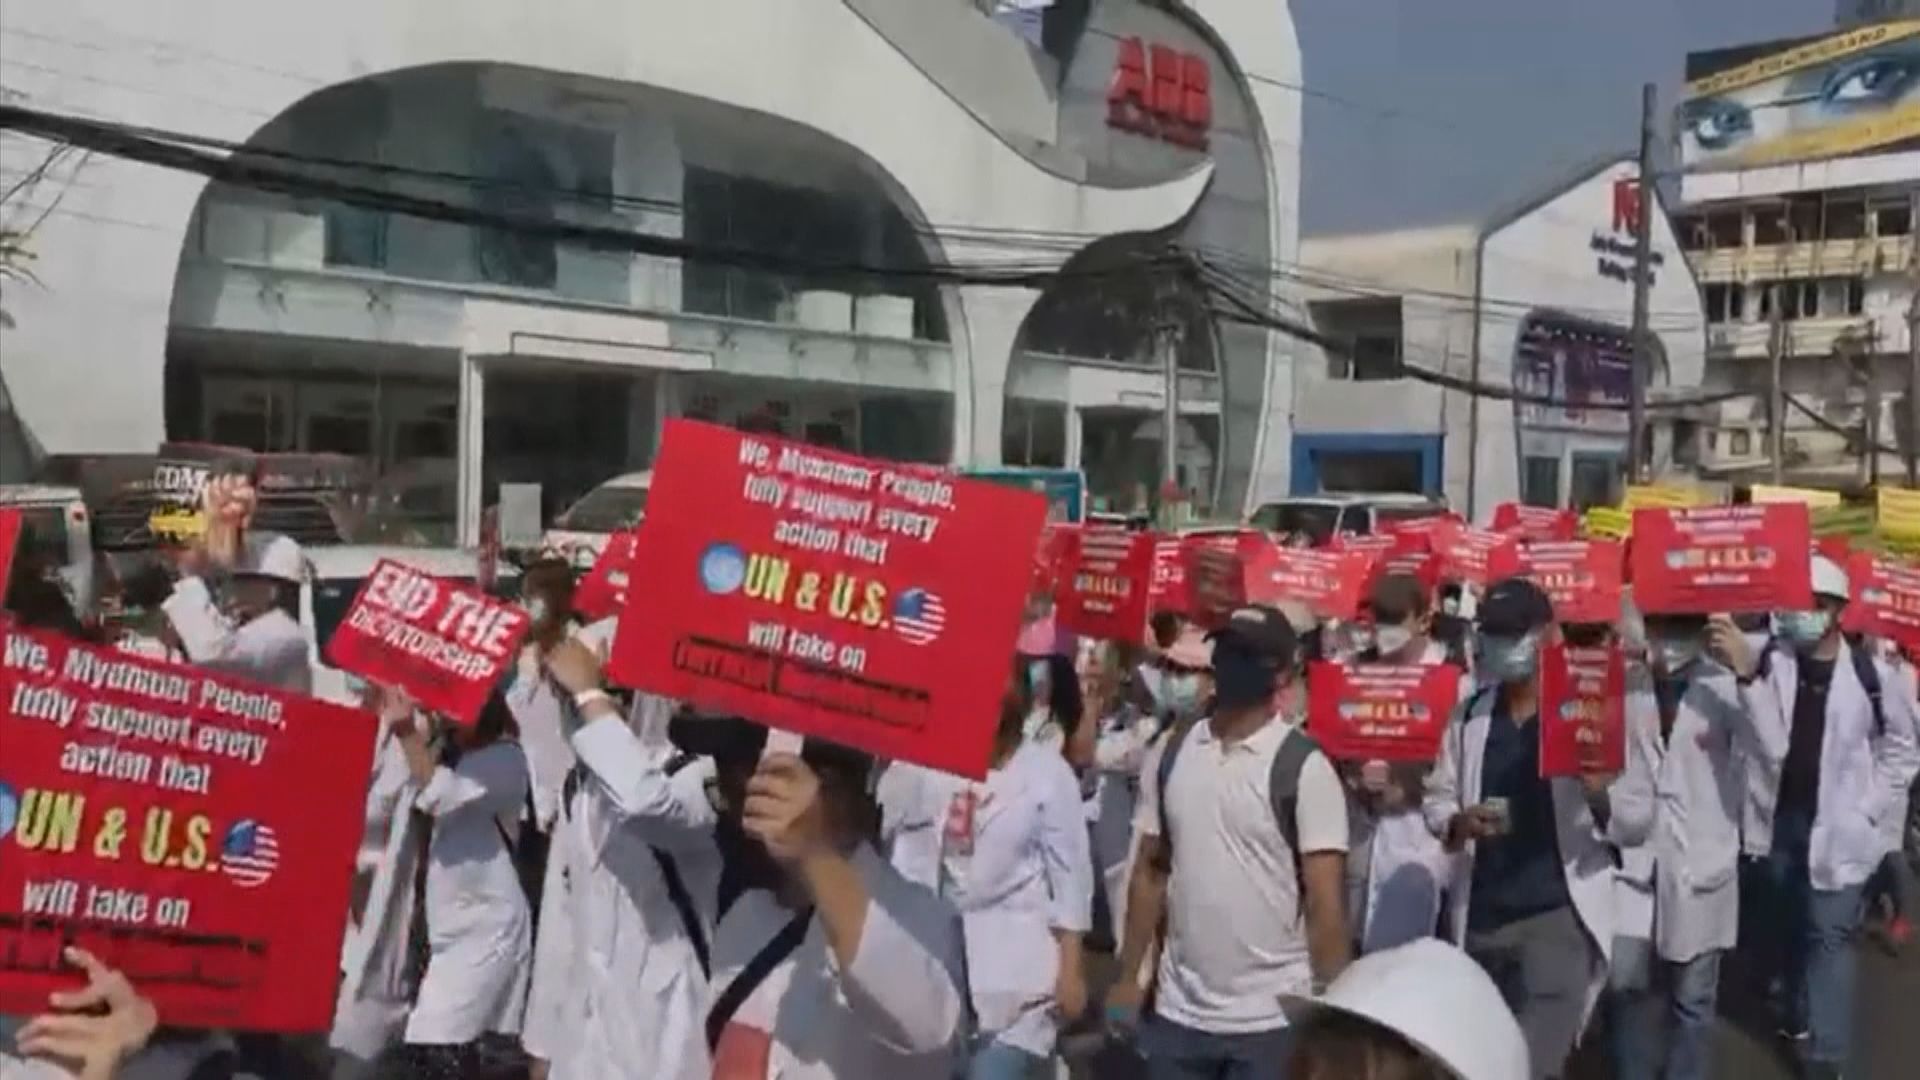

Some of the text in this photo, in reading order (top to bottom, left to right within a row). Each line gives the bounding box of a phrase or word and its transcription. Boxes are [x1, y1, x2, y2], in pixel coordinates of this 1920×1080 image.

[777, 446, 880, 491] Myanmar
[744, 473, 939, 543] fully support every
[774, 520, 889, 566] action that
[437, 590, 522, 656] THE
[743, 553, 890, 629] UN & U.S.
[3, 633, 55, 677] We,
[63, 647, 195, 703] Myanmar
[748, 620, 867, 672] will take on
[9, 681, 268, 766] fully support every
[60, 741, 211, 794] action that
[14, 787, 220, 873] UN & U.S.
[22, 879, 191, 928] will take on
